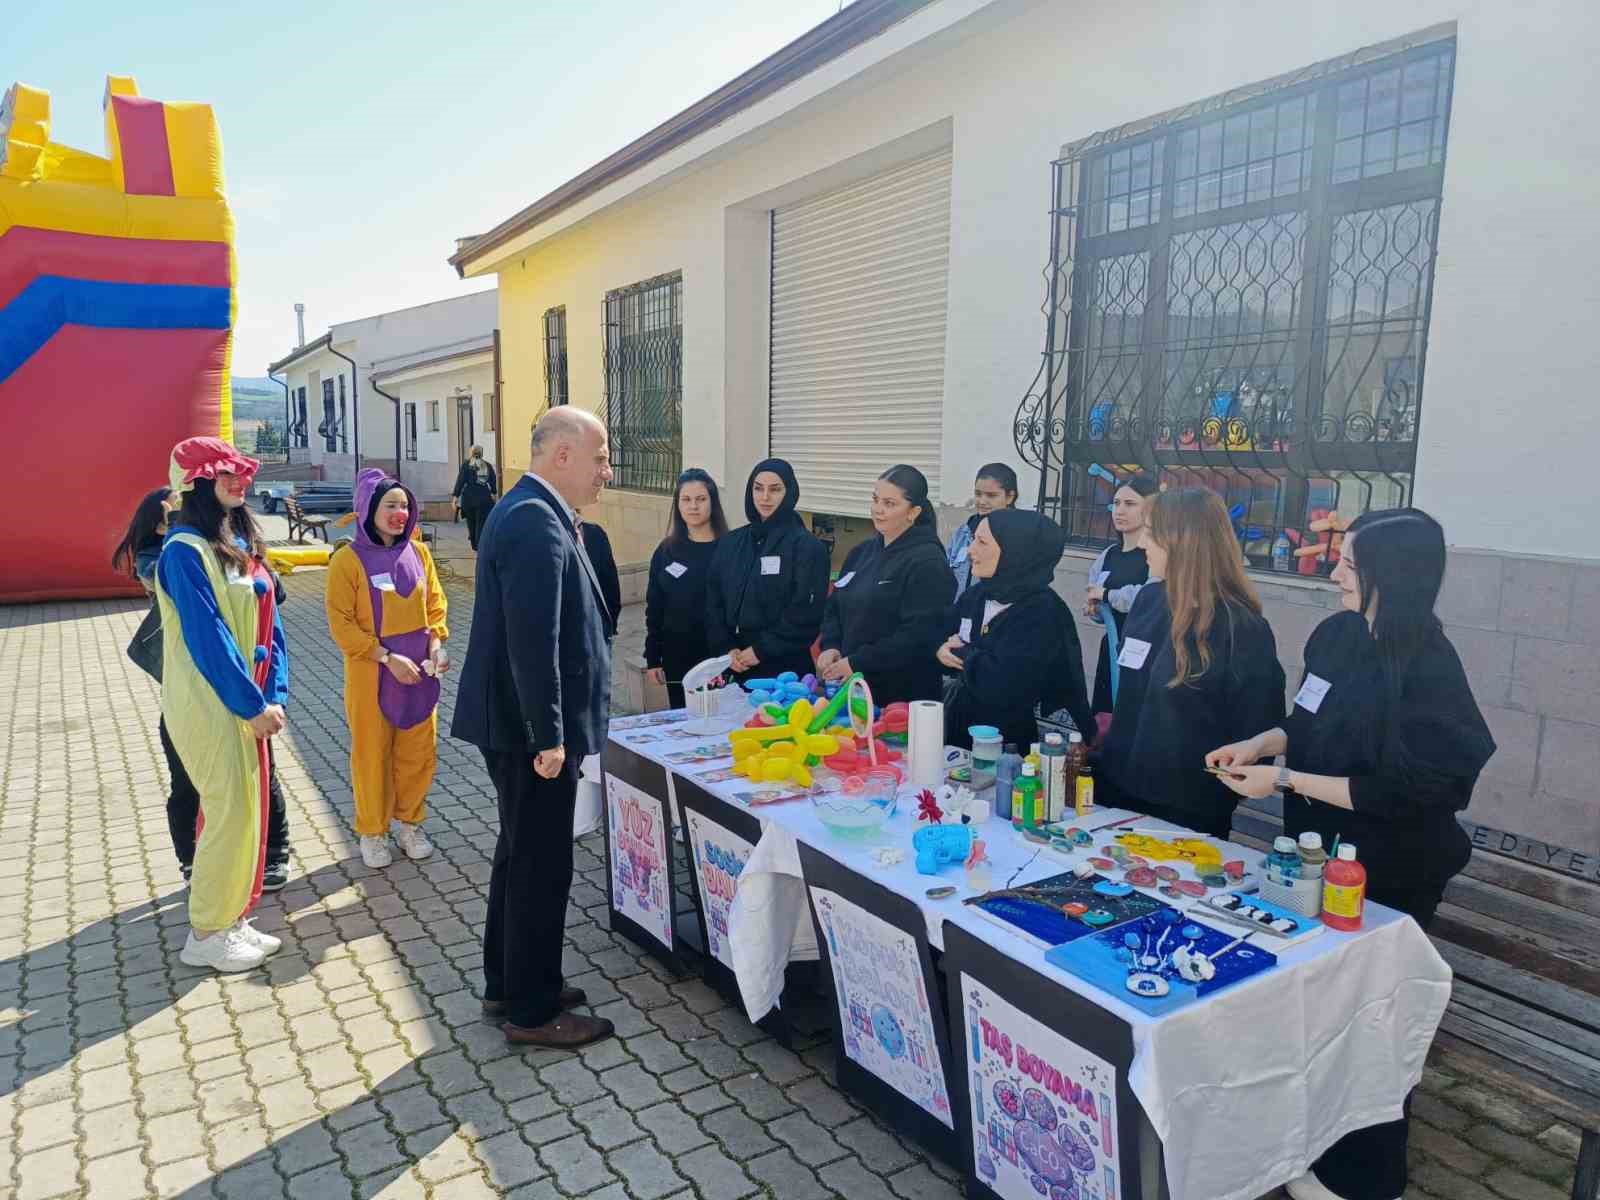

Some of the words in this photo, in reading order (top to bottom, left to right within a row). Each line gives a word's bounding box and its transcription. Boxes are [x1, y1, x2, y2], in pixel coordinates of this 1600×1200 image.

[618, 796, 654, 848] YÜZ
[1471, 825, 1600, 878] EDİYE
[980, 1016, 1013, 1069] TAŞ
[1016, 1042, 1099, 1122] BOYAMA
